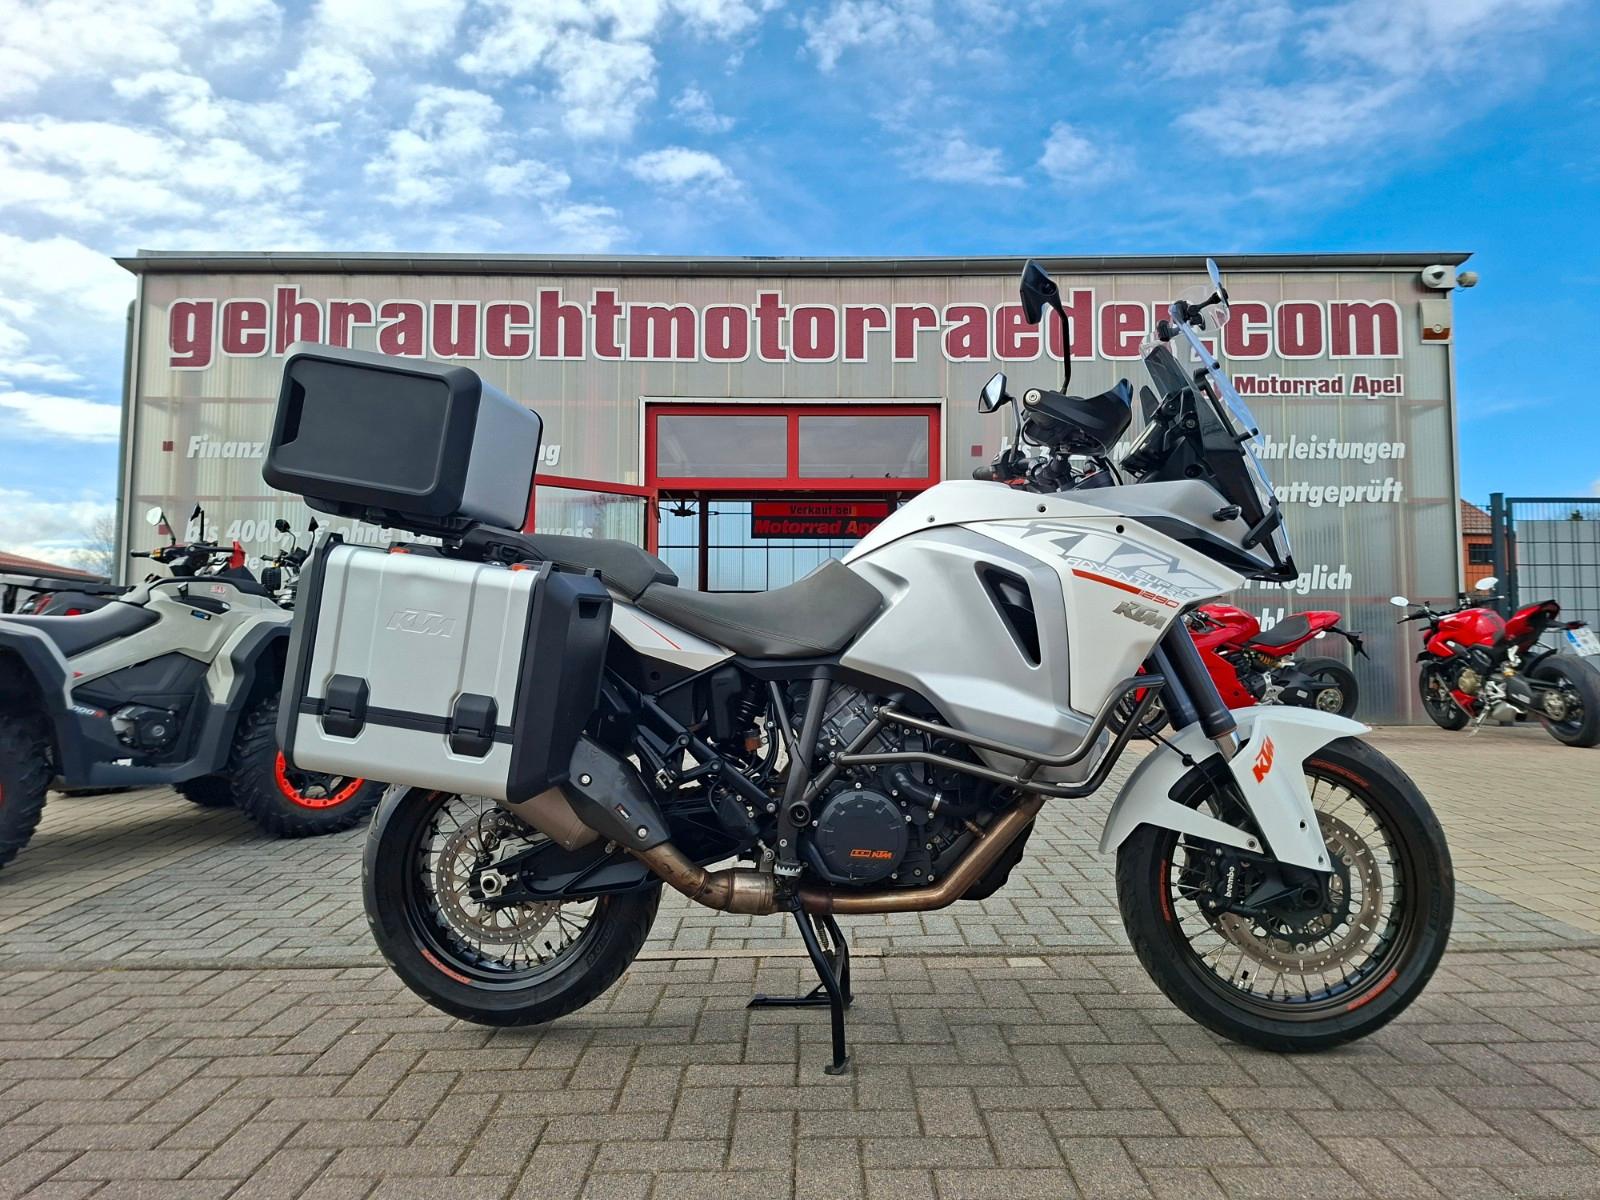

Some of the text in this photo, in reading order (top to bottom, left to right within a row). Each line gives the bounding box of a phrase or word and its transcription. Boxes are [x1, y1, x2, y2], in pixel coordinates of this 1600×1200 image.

[1232, 374, 1345, 396] Motorrad
[1350, 374, 1404, 399] Apel
[187, 433, 265, 458] Finanz
[1250, 434, 1405, 464] ahrleistungen
[1270, 477, 1403, 507] attgeprüft
[789, 505, 832, 515] Verkauf
[754, 519, 841, 534] Motorrad
[1139, 590, 1180, 609] 1290
[385, 608, 457, 639] KTM
[1112, 601, 1168, 630] KTM
[1252, 735, 1275, 785] KTM
[1224, 866, 1235, 898] brembo
